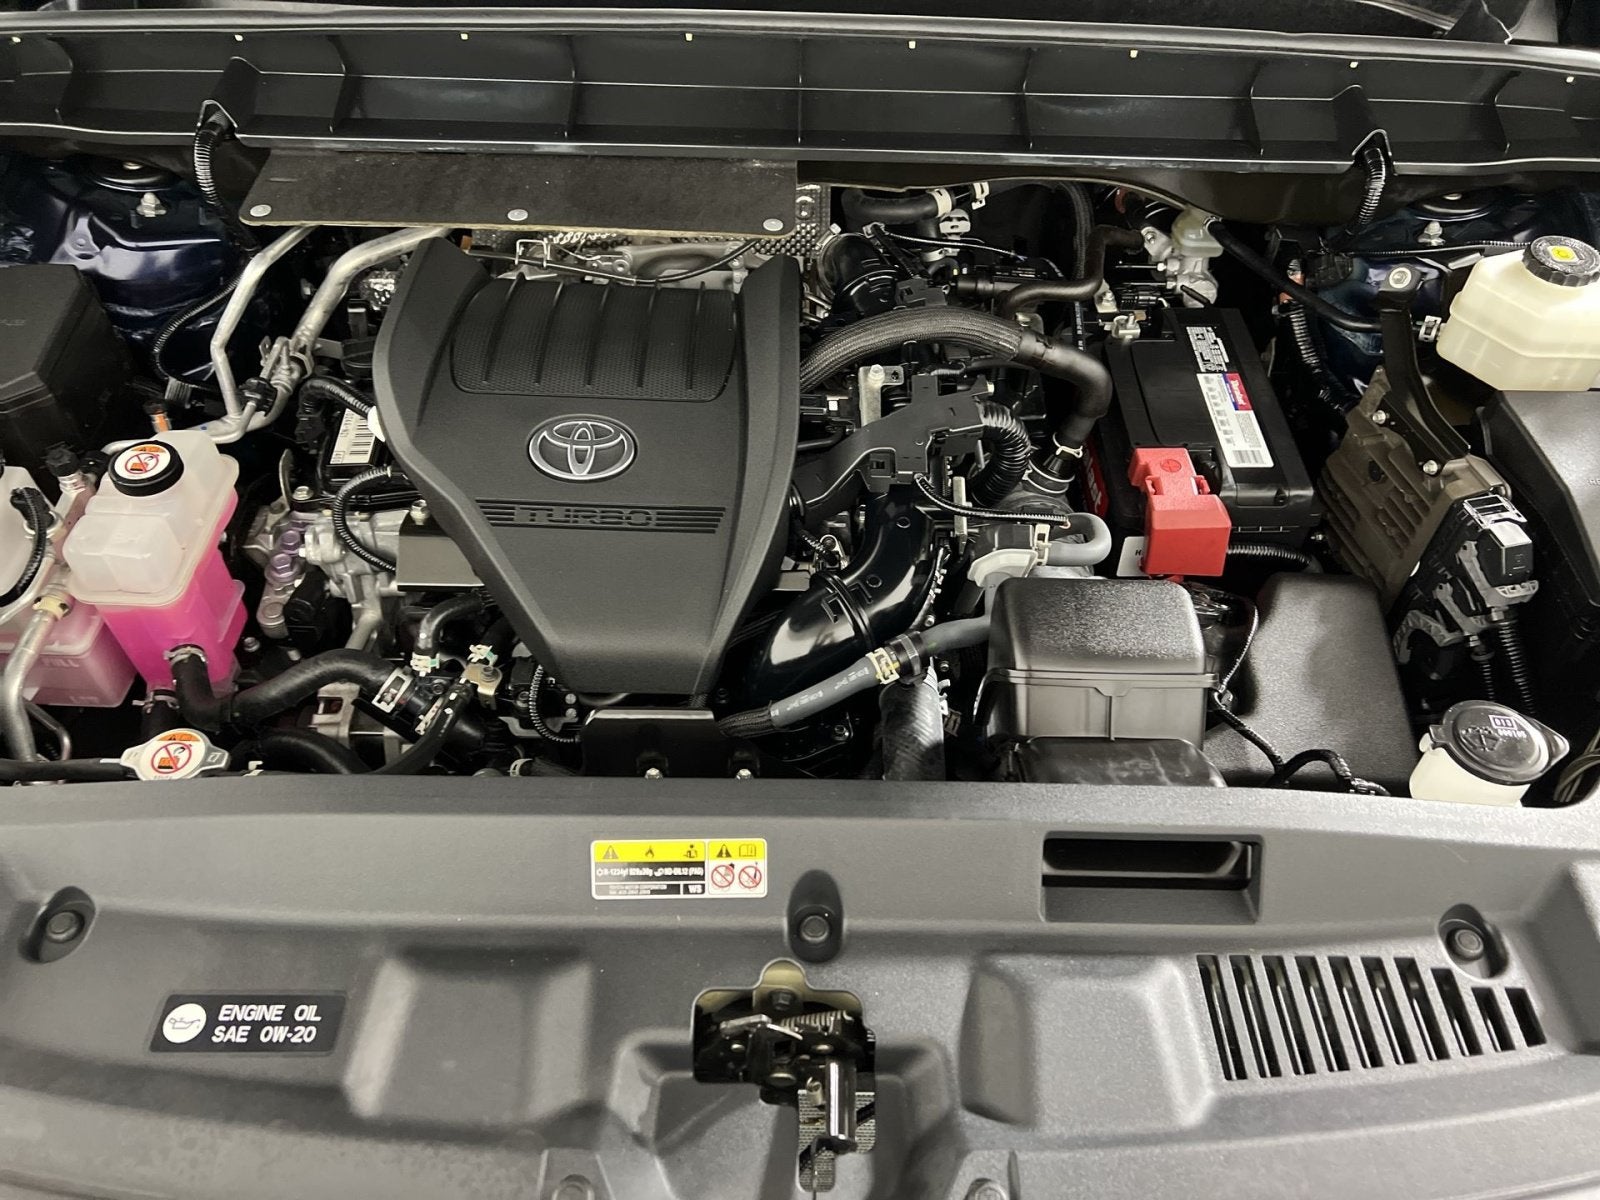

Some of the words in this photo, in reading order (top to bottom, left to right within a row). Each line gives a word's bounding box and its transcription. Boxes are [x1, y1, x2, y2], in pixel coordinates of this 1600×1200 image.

[518, 506, 653, 527] TURBO
[217, 1004, 286, 1022] ENGINE
[293, 1004, 322, 1022] OIL
[211, 1025, 251, 1043] SAE
[259, 1025, 317, 1043] 0W-20
